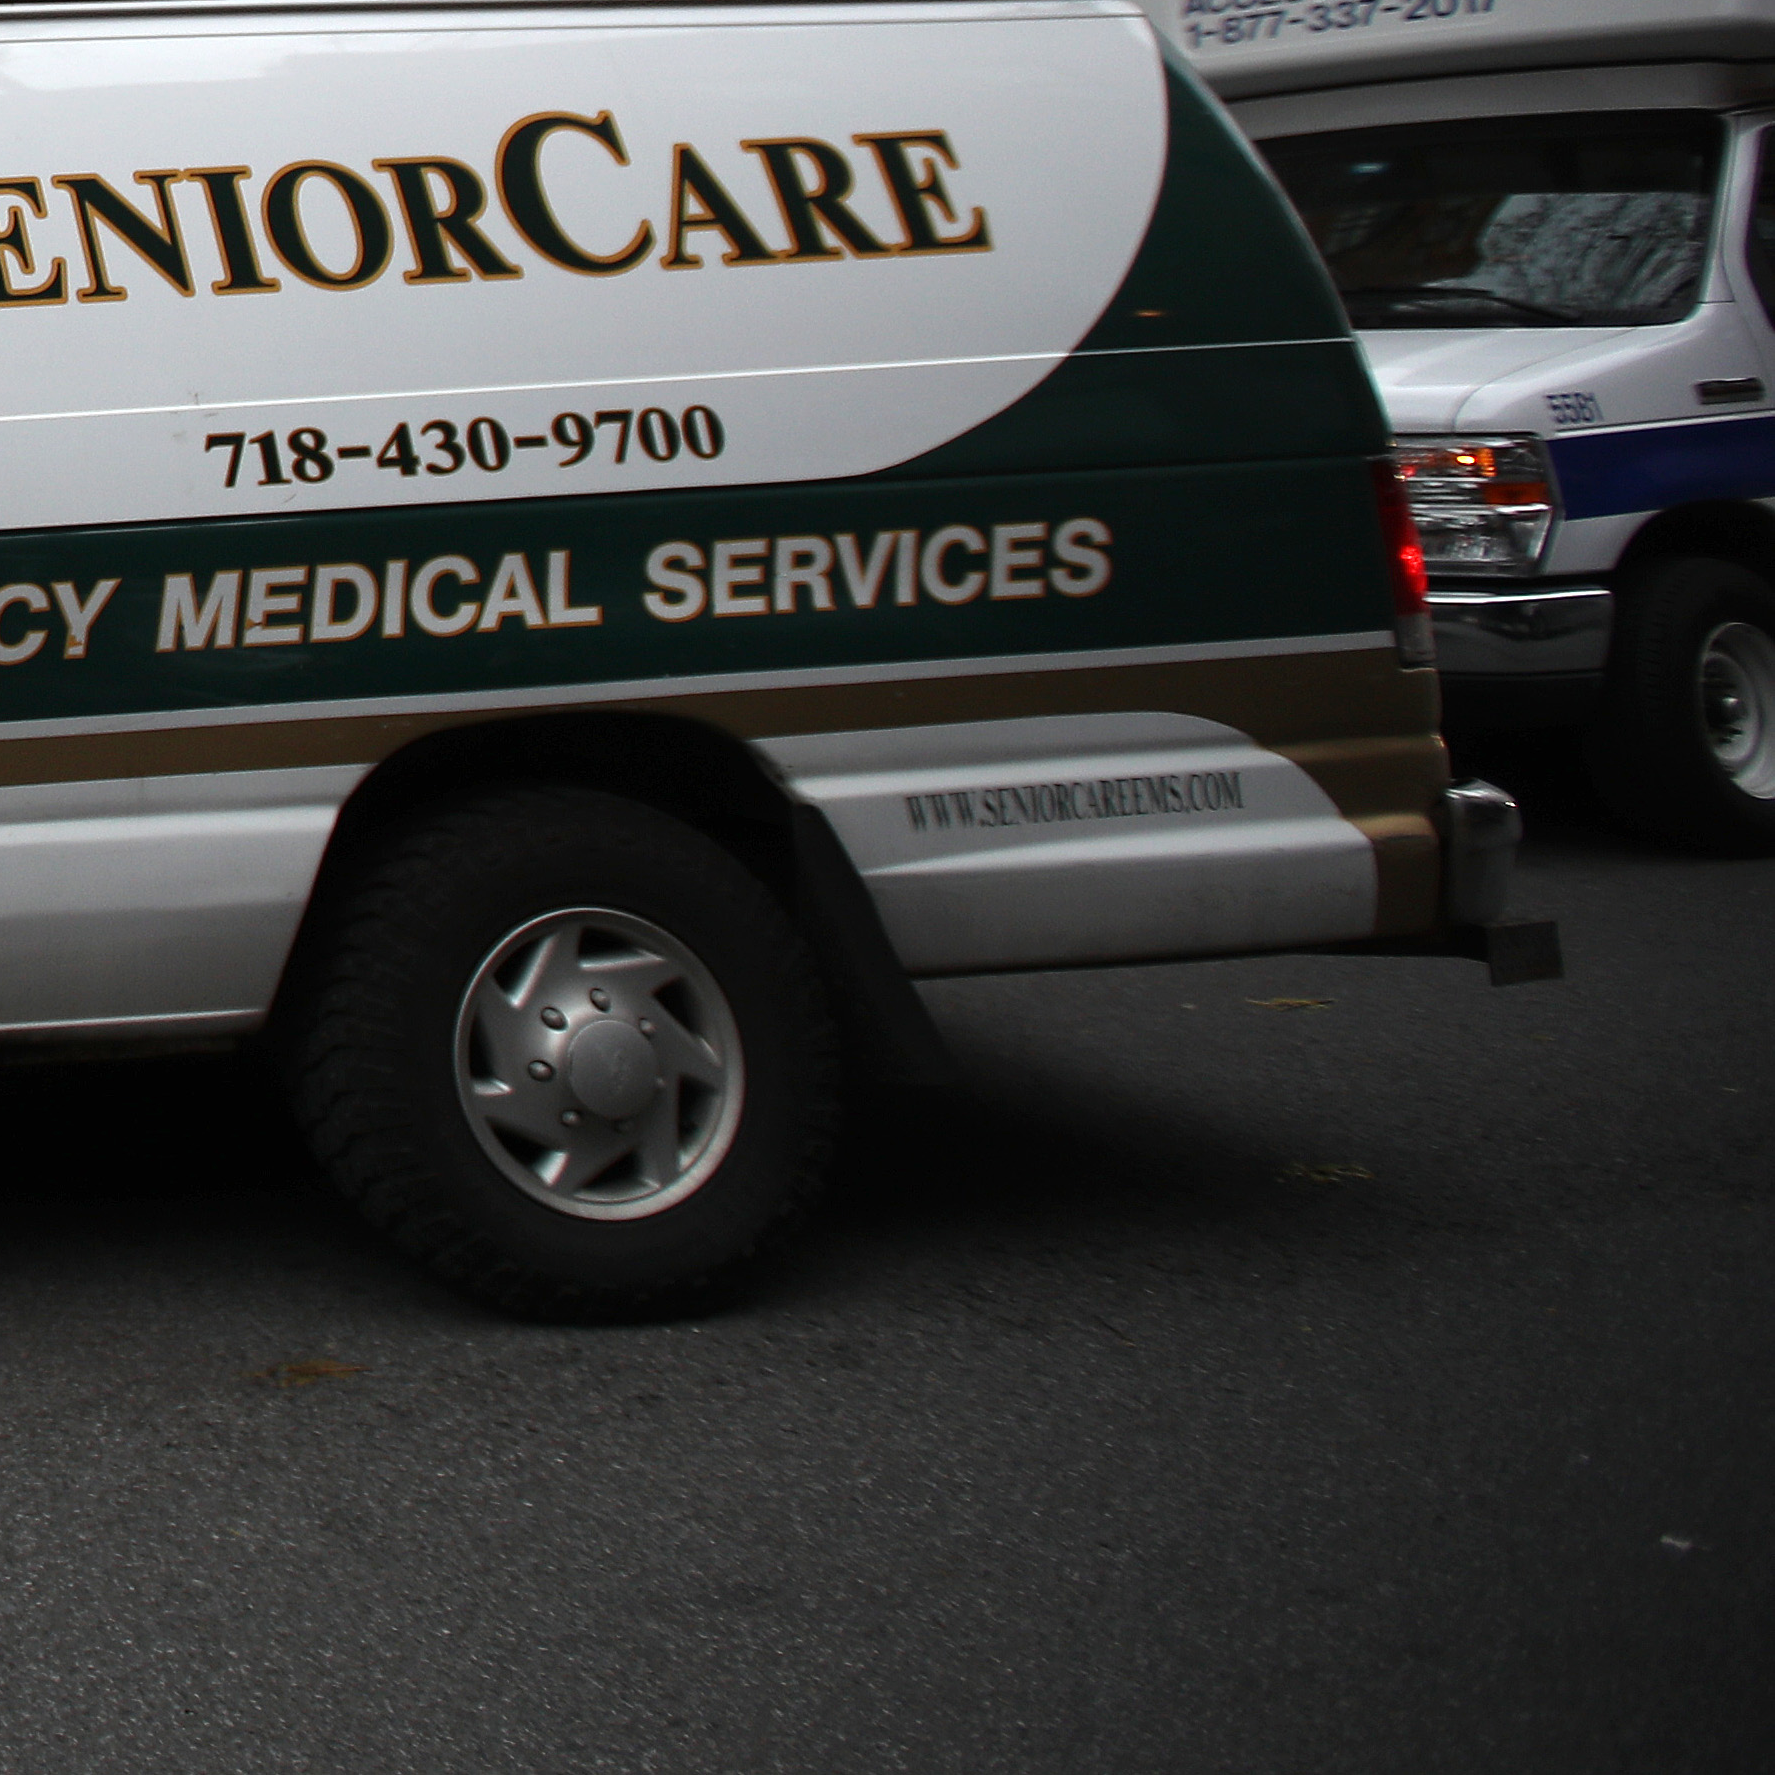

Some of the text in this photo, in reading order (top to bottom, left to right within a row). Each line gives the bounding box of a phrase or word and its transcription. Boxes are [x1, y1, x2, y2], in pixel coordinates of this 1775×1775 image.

[203, 403, 727, 488] 718-430-9700
[154, 550, 602, 653] MEDICAL
[642, 517, 1114, 624] SERVICES
